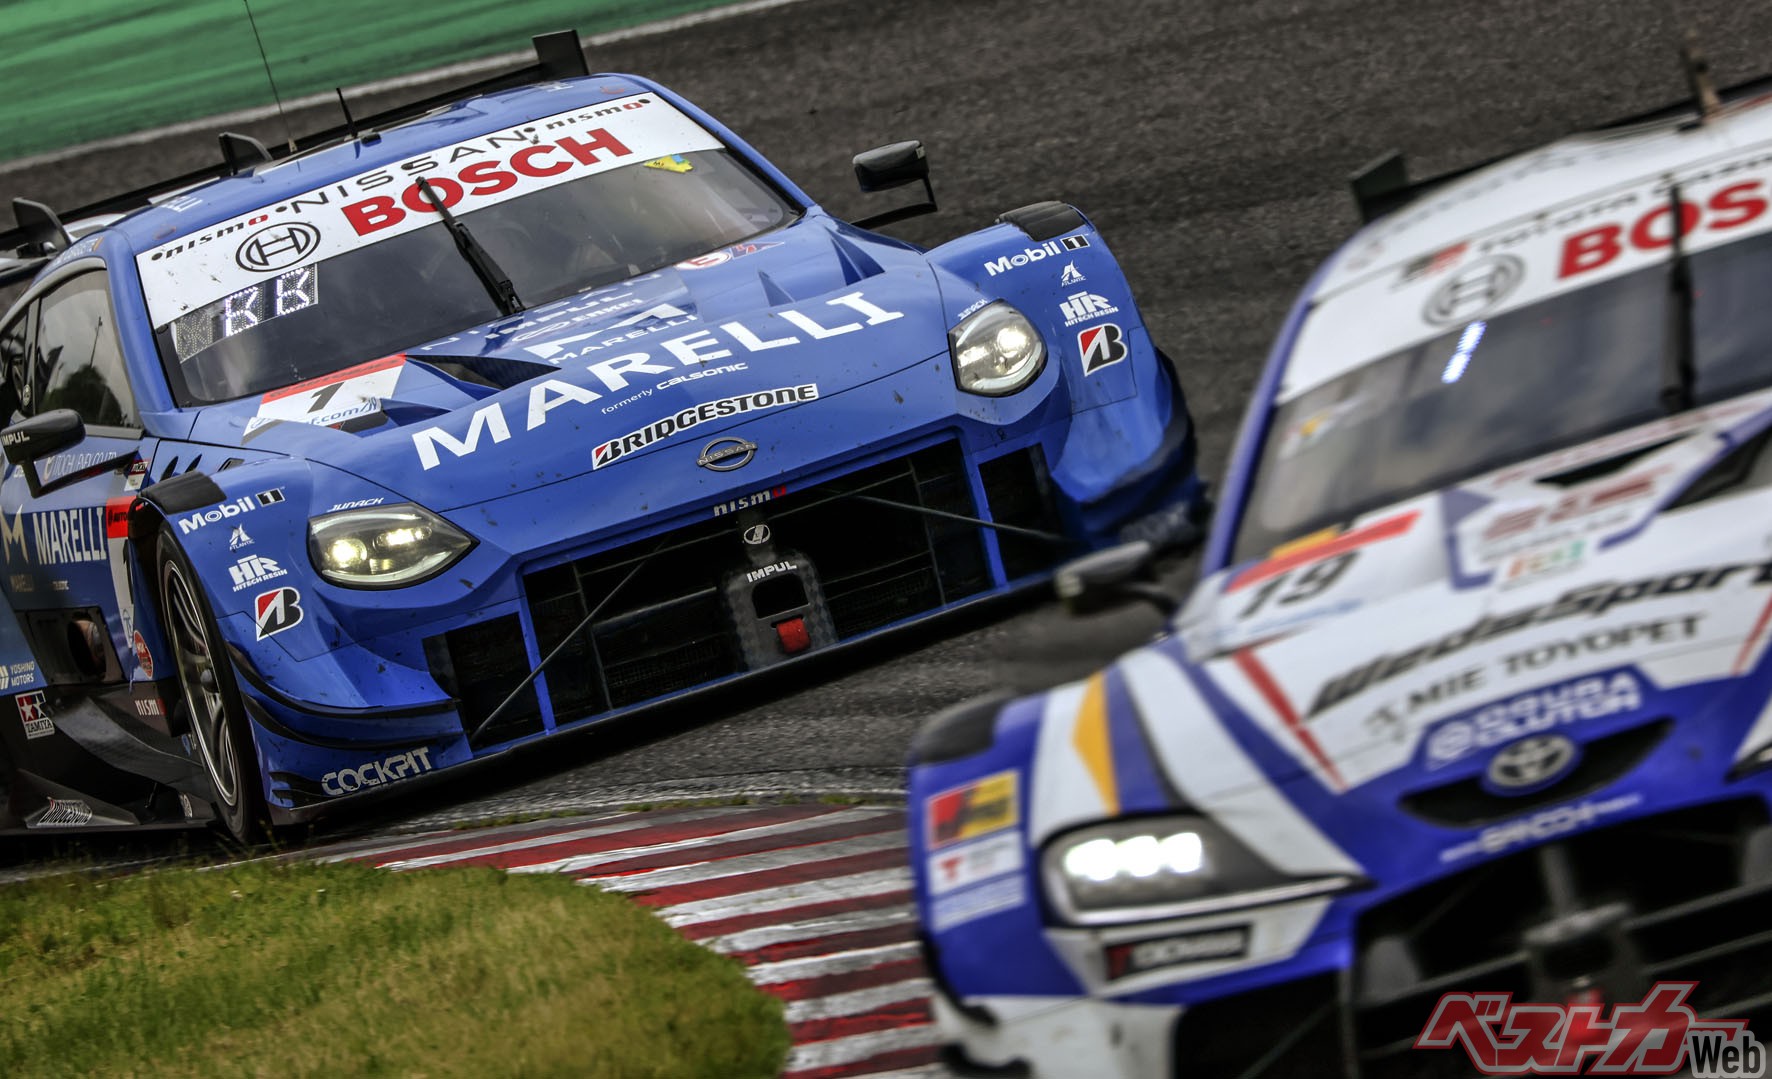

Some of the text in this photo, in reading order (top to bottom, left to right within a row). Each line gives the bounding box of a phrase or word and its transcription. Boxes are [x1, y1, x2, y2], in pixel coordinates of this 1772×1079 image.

[165, 101, 643, 259] nismo NISSAN nismo
[341, 127, 634, 237] BOSCH
[1557, 180, 1772, 281] BOS
[984, 241, 1062, 277] Mobil
[1064, 306, 1119, 328] HITECH RESIN
[549, 314, 698, 365] MARELLI
[307, 381, 345, 414] 1
[410, 291, 905, 471] MARELLI
[601, 386, 653, 415] formerly
[593, 384, 819, 470] BRIDGESTONE
[698, 442, 757, 465] NISSAN
[178, 496, 256, 534] Mobil
[713, 485, 787, 517] nismo
[32, 506, 107, 565] MARELLI
[232, 569, 288, 592] HITECH RESIN
[746, 560, 797, 583] IMPUL
[1236, 550, 1361, 620] 19
[1503, 615, 1704, 675] TOYOPET
[10, 661, 35, 674] YOSHINO
[11, 673, 34, 687] MOTORS
[25, 719, 53, 732] TAMIYA
[321, 747, 432, 796] COCKPIT
